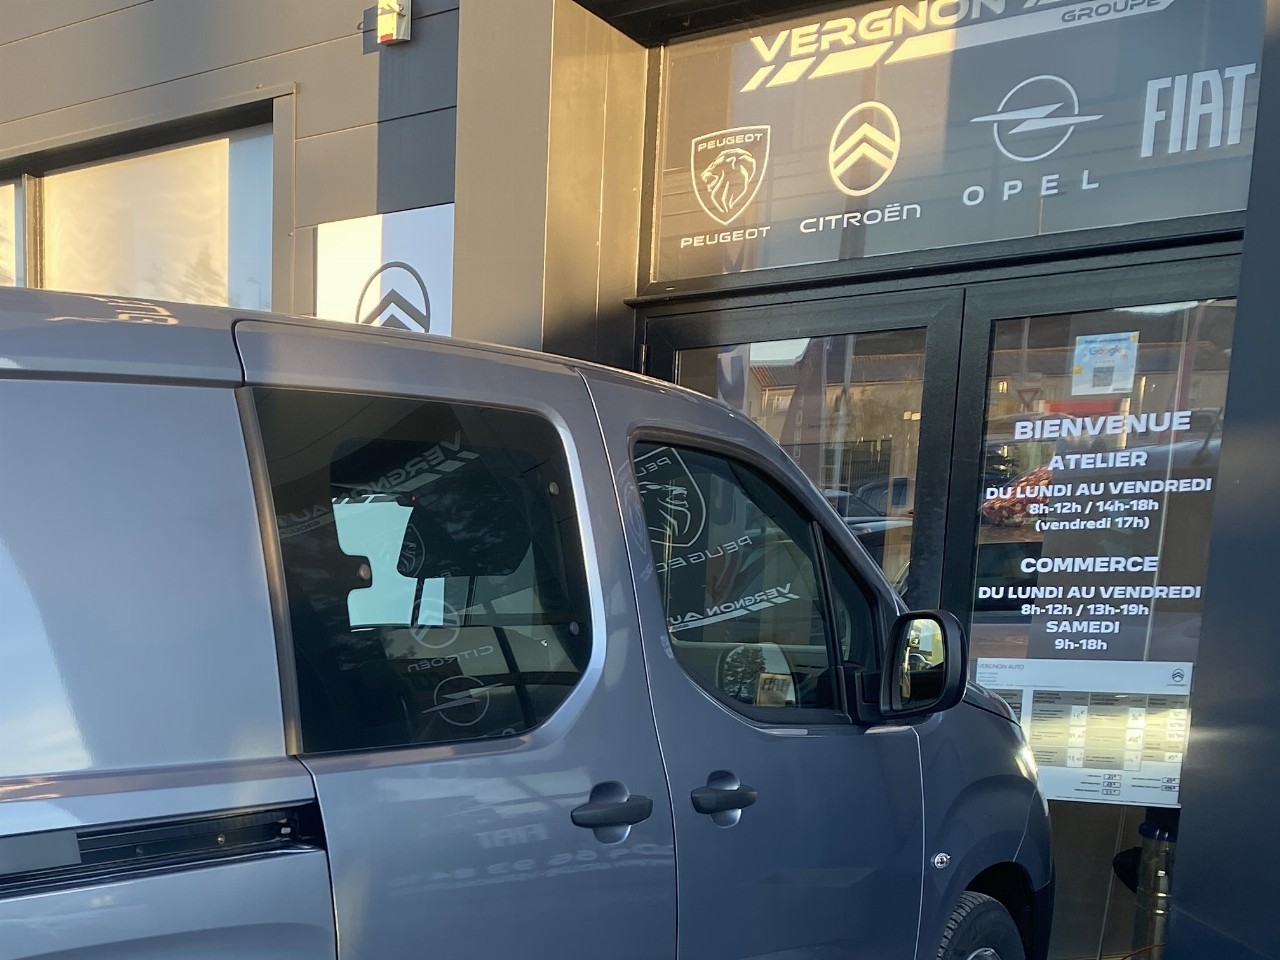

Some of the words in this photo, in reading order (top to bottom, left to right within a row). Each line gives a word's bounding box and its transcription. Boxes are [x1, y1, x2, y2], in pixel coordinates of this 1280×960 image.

[749, 0, 1004, 63] VERGNON
[1140, 62, 1257, 158] FIAT
[697, 132, 764, 152] PEUGEOT
[962, 169, 1100, 206] OPEL
[680, 226, 771, 249] PEUGEOT
[1014, 410, 1192, 440] BIENVENUE
[1048, 451, 1148, 471] ATELIER
[985, 486, 1013, 500] DU
[1016, 483, 1072, 499] LUNDI
[1076, 482, 1105, 496] AU
[1108, 478, 1213, 495] VENDREDI
[1028, 501, 1082, 515] 8h-12h
[1084, 501, 1094, 515] /
[1096, 498, 1160, 513] 14h-18h
[1035, 517, 1111, 532] (vendredi
[1116, 516, 1150, 530] 17h)
[1020, 556, 1160, 573] COMMERCE
[978, 586, 1006, 599] DU
[1007, 586, 1064, 599] LUNDI
[1067, 586, 1096, 599] AU
[1099, 585, 1202, 599] VENDREDI
[1021, 603, 1073, 616] 8h-12h
[1075, 604, 1085, 617] /
[1087, 603, 1150, 616] 13h-19h
[1045, 620, 1121, 634] SAMEDI
[1054, 638, 1108, 651] 9h-18h
[978, 663, 1007, 671] VERGNON
